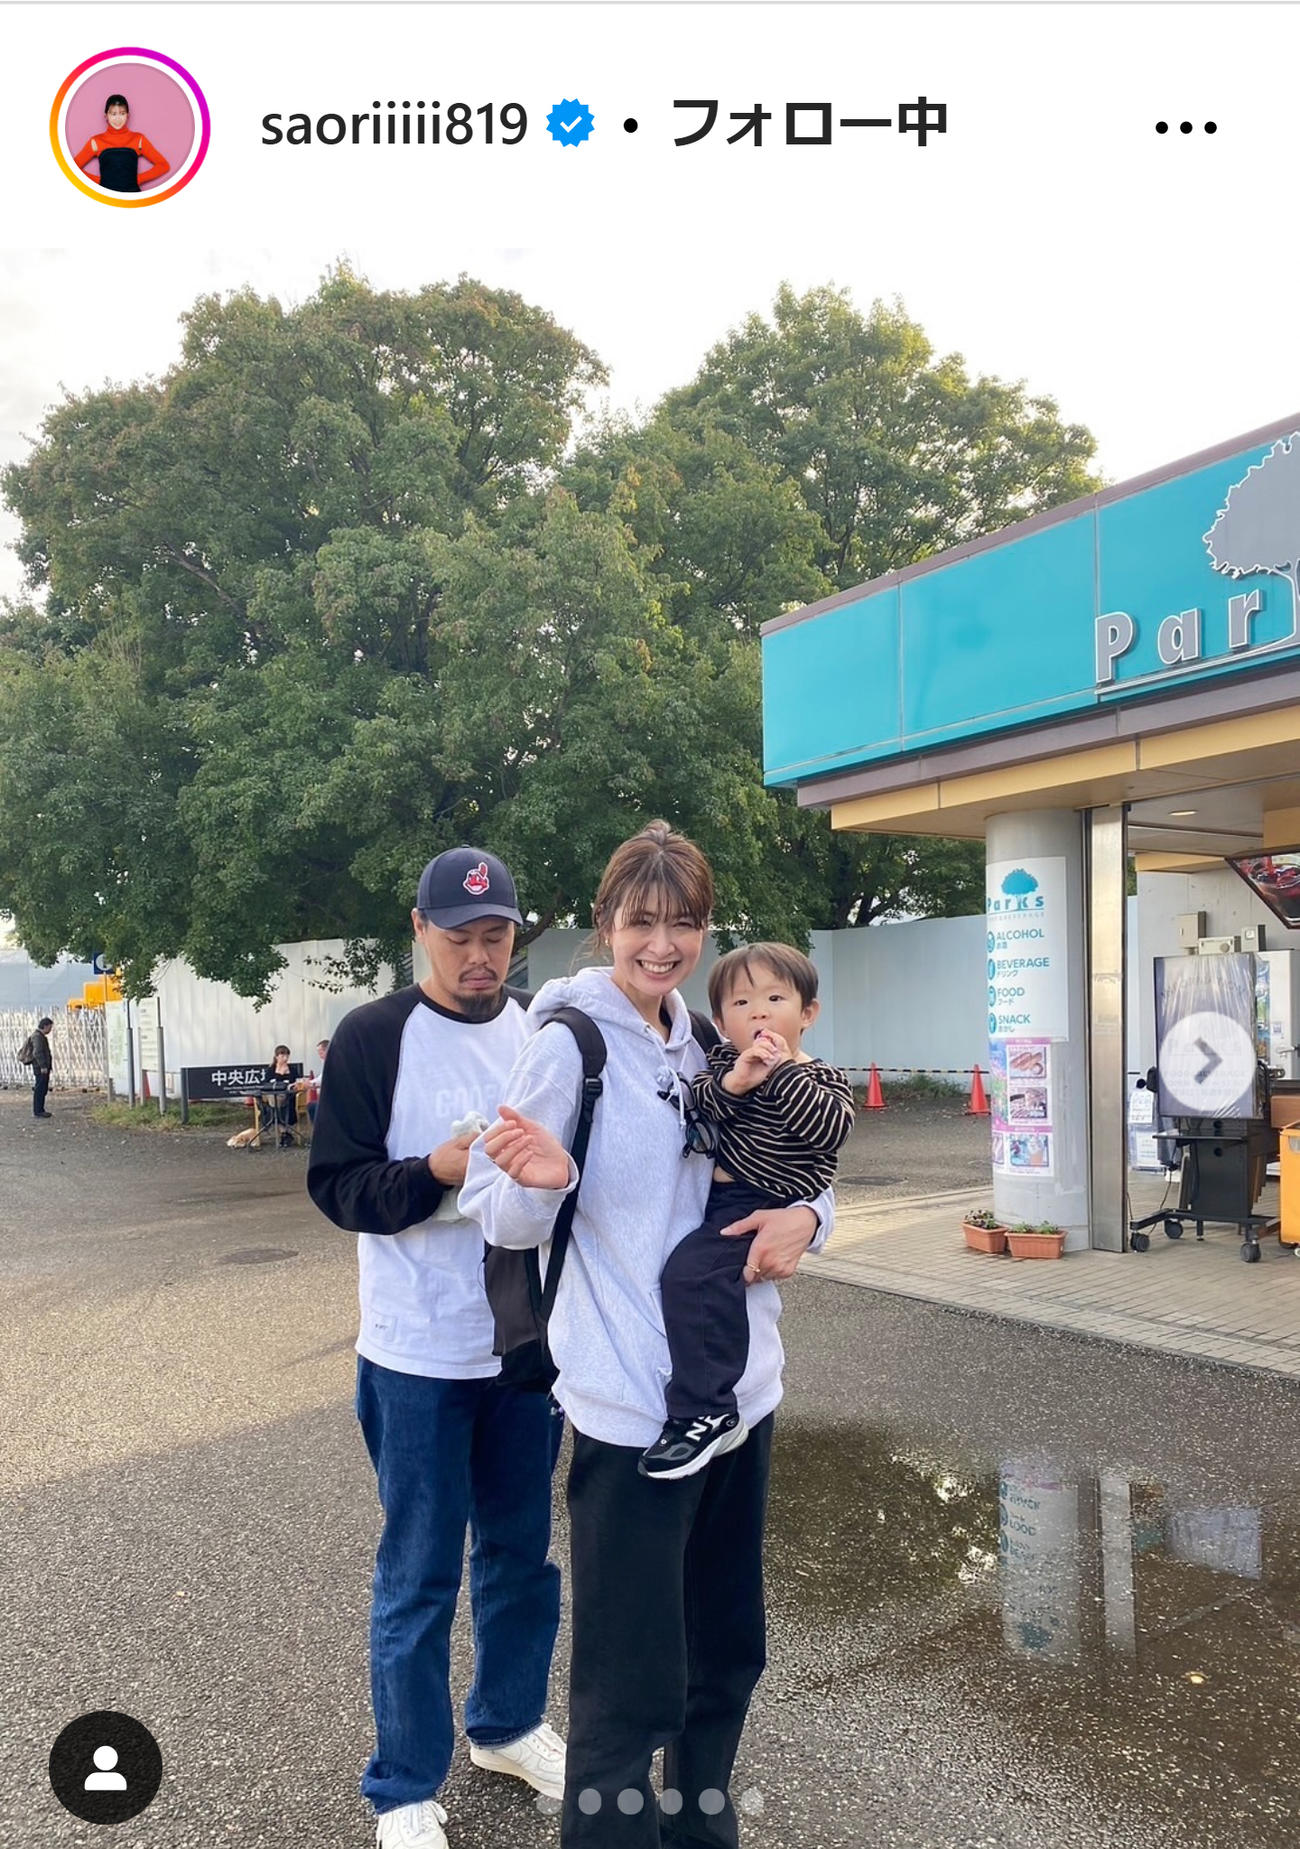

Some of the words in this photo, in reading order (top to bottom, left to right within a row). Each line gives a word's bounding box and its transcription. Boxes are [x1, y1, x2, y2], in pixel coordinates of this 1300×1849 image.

[996, 928, 1045, 941] ALCOHOL
[997, 957, 1050, 970] BEVERAGE
[998, 987, 1025, 997] FOOD
[998, 1014, 1031, 1025] SNACK
